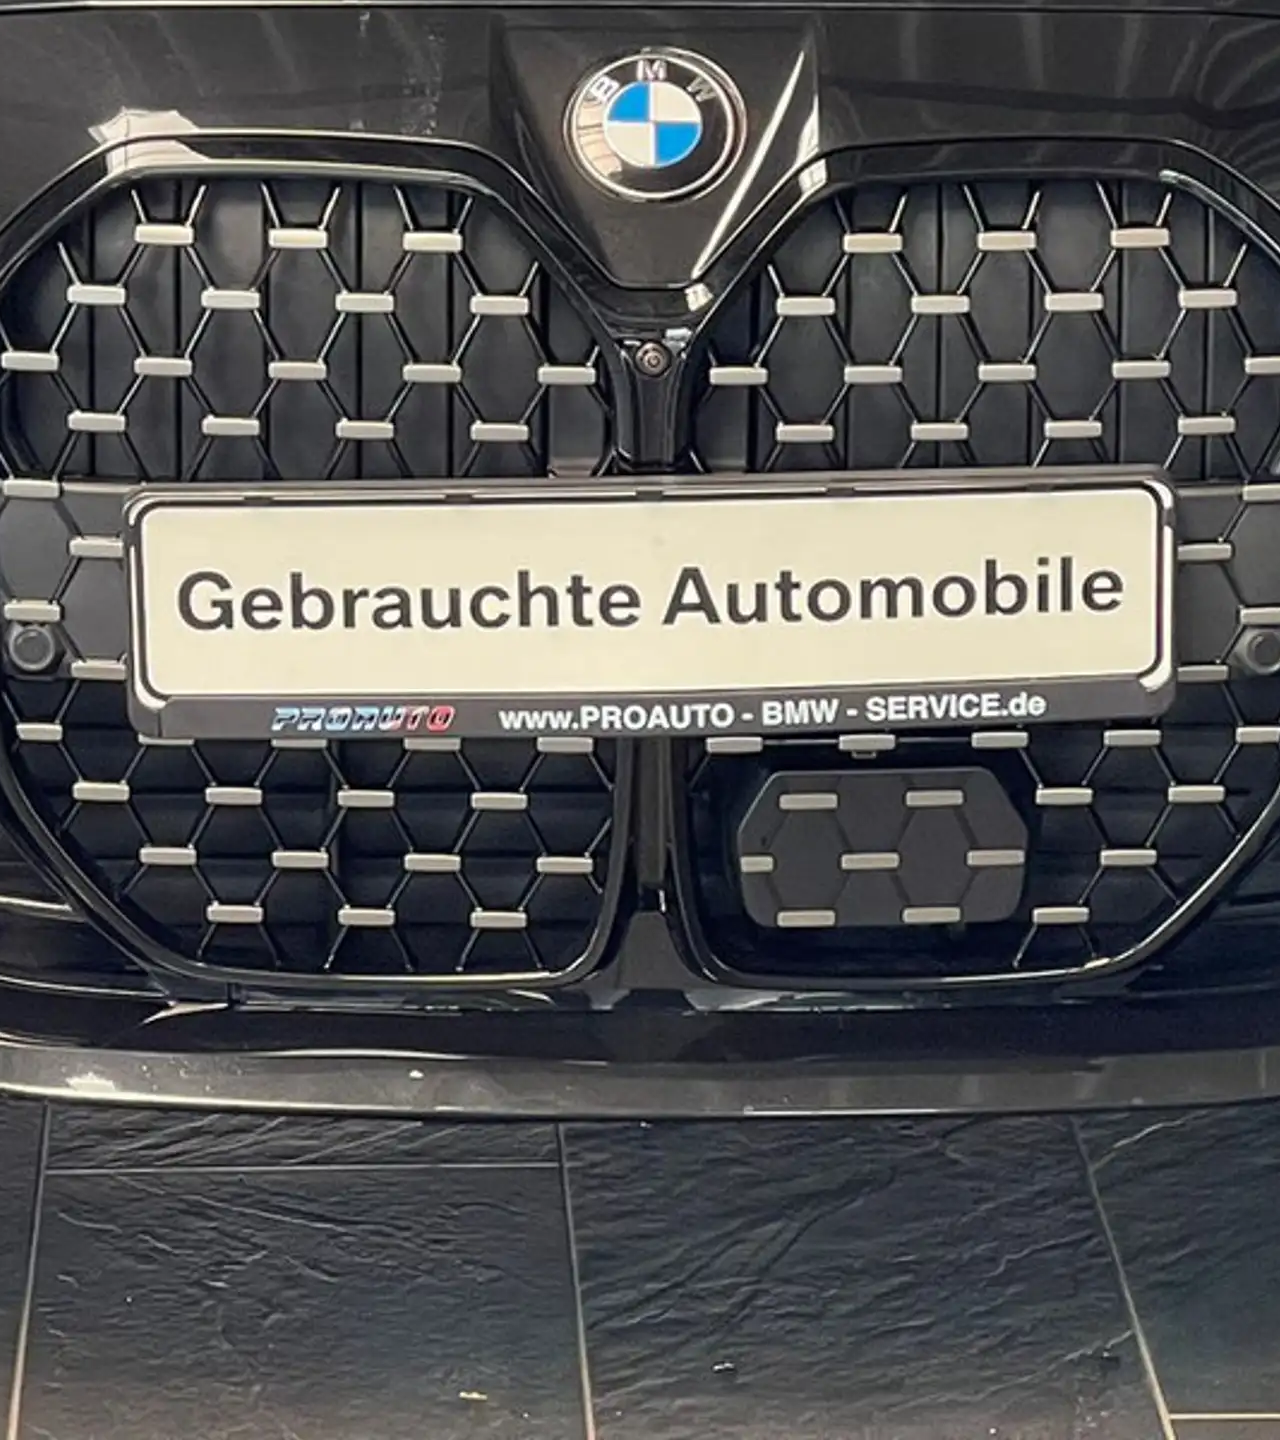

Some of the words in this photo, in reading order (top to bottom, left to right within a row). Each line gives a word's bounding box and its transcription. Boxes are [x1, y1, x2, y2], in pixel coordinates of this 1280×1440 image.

[589, 59, 717, 104] BMW
[177, 569, 642, 631] Gebrauchte
[661, 556, 1125, 626] Automobile
[270, 704, 456, 732] PROAUTO
[498, 703, 735, 731] www.PROAUTO
[762, 698, 840, 725] BMW
[865, 692, 1047, 723] SERVICE.de
